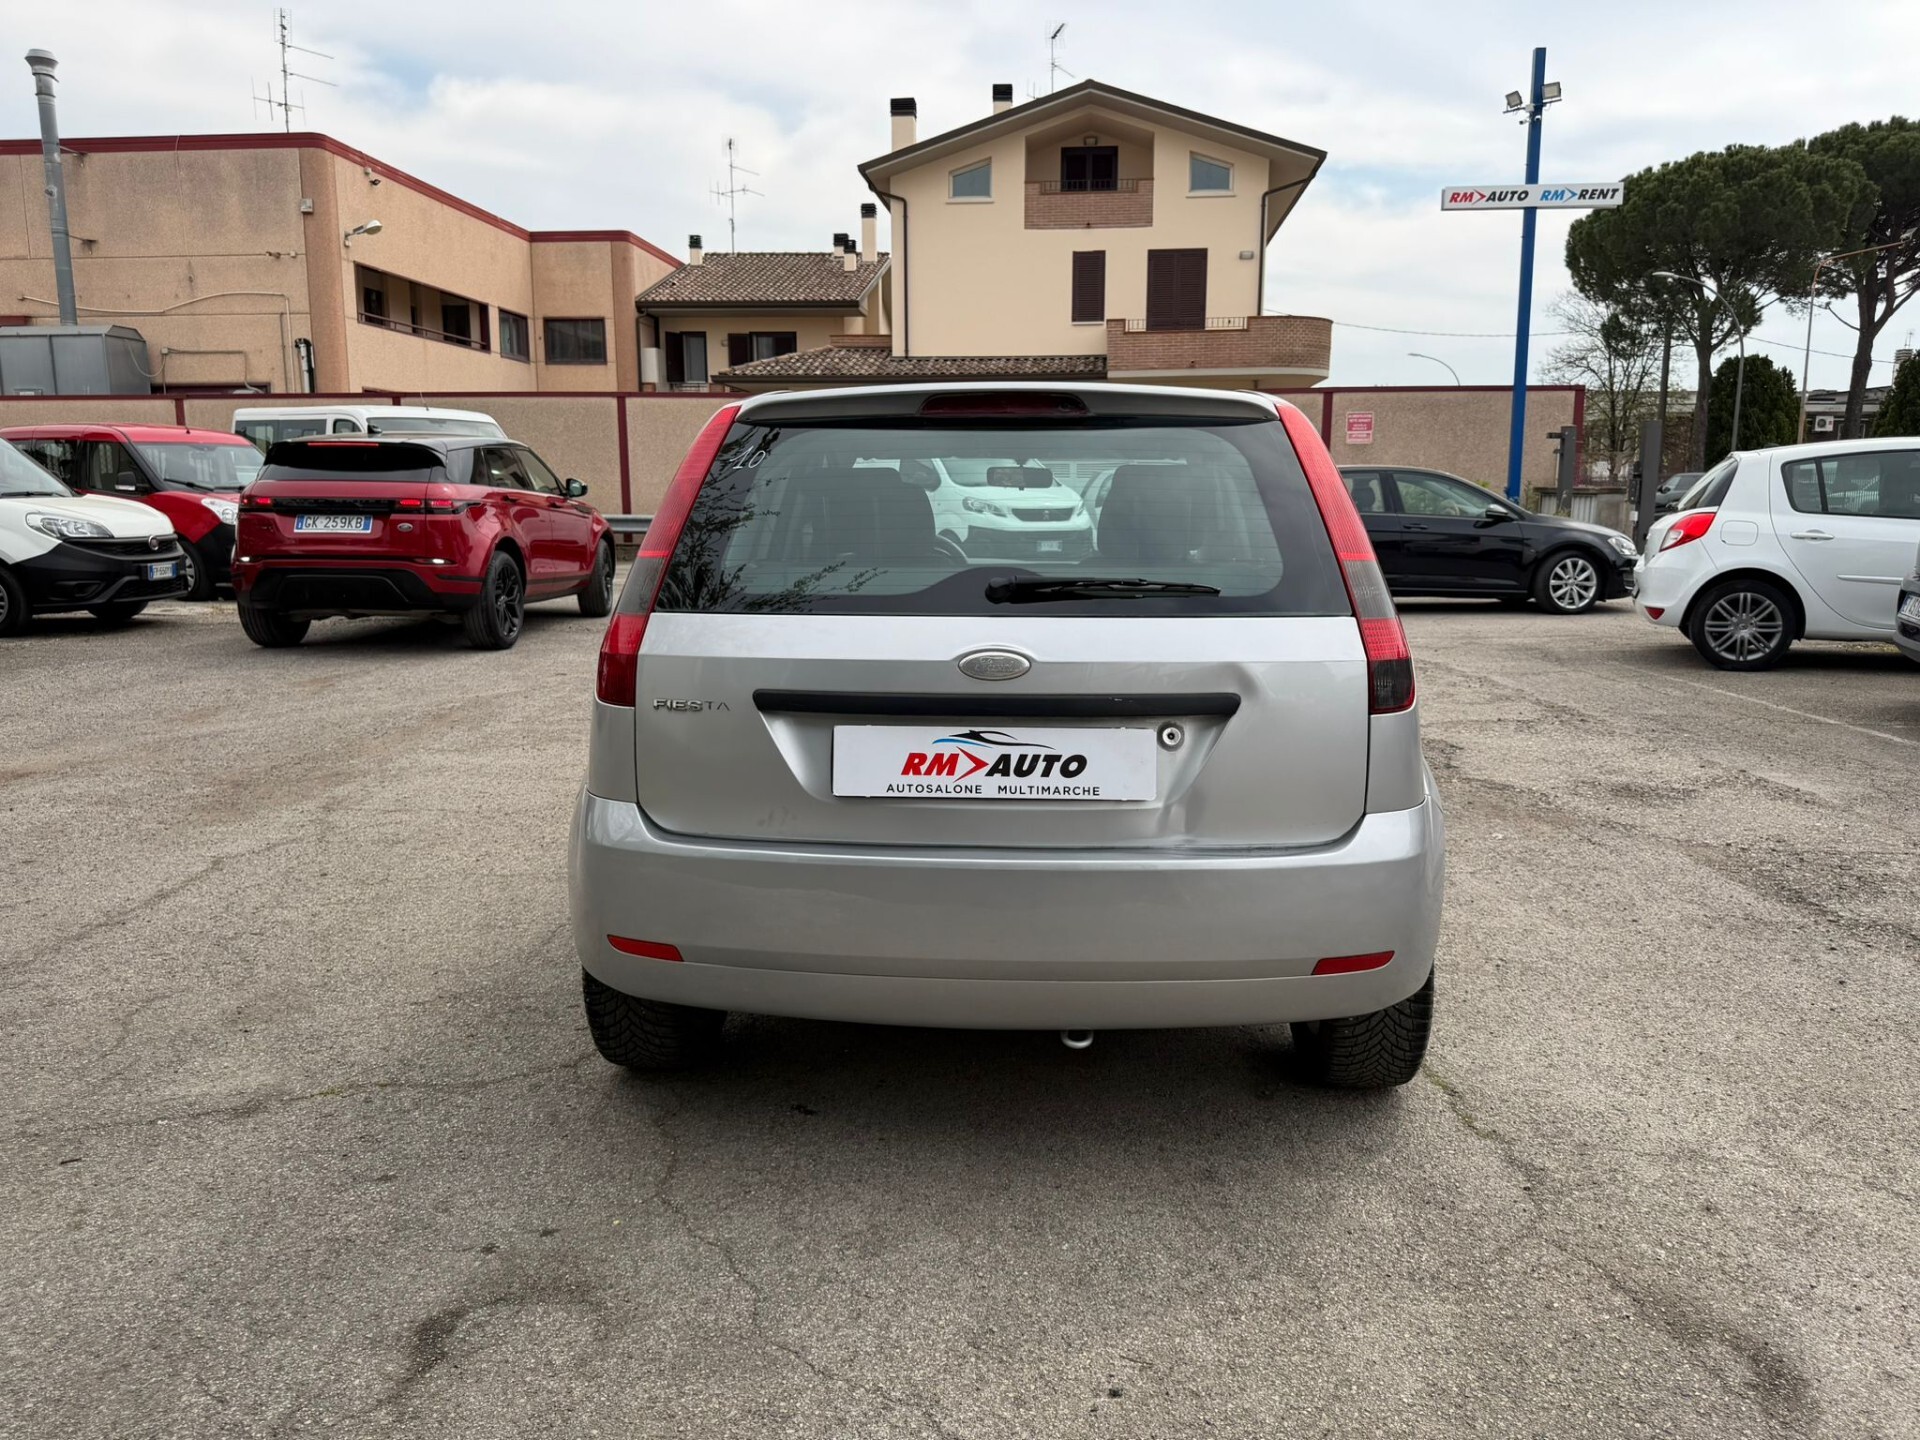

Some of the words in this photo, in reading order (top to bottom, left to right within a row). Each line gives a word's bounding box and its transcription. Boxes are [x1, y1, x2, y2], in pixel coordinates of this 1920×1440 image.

[729, 445, 766, 469] 10
[304, 516, 320, 528] GK
[324, 516, 363, 529] 259KB
[653, 698, 731, 712] FIESTA
[985, 754, 1088, 778] AUTO
[886, 783, 983, 795] AUTOSALONE
[997, 785, 1101, 797] MULTIMARCHE
